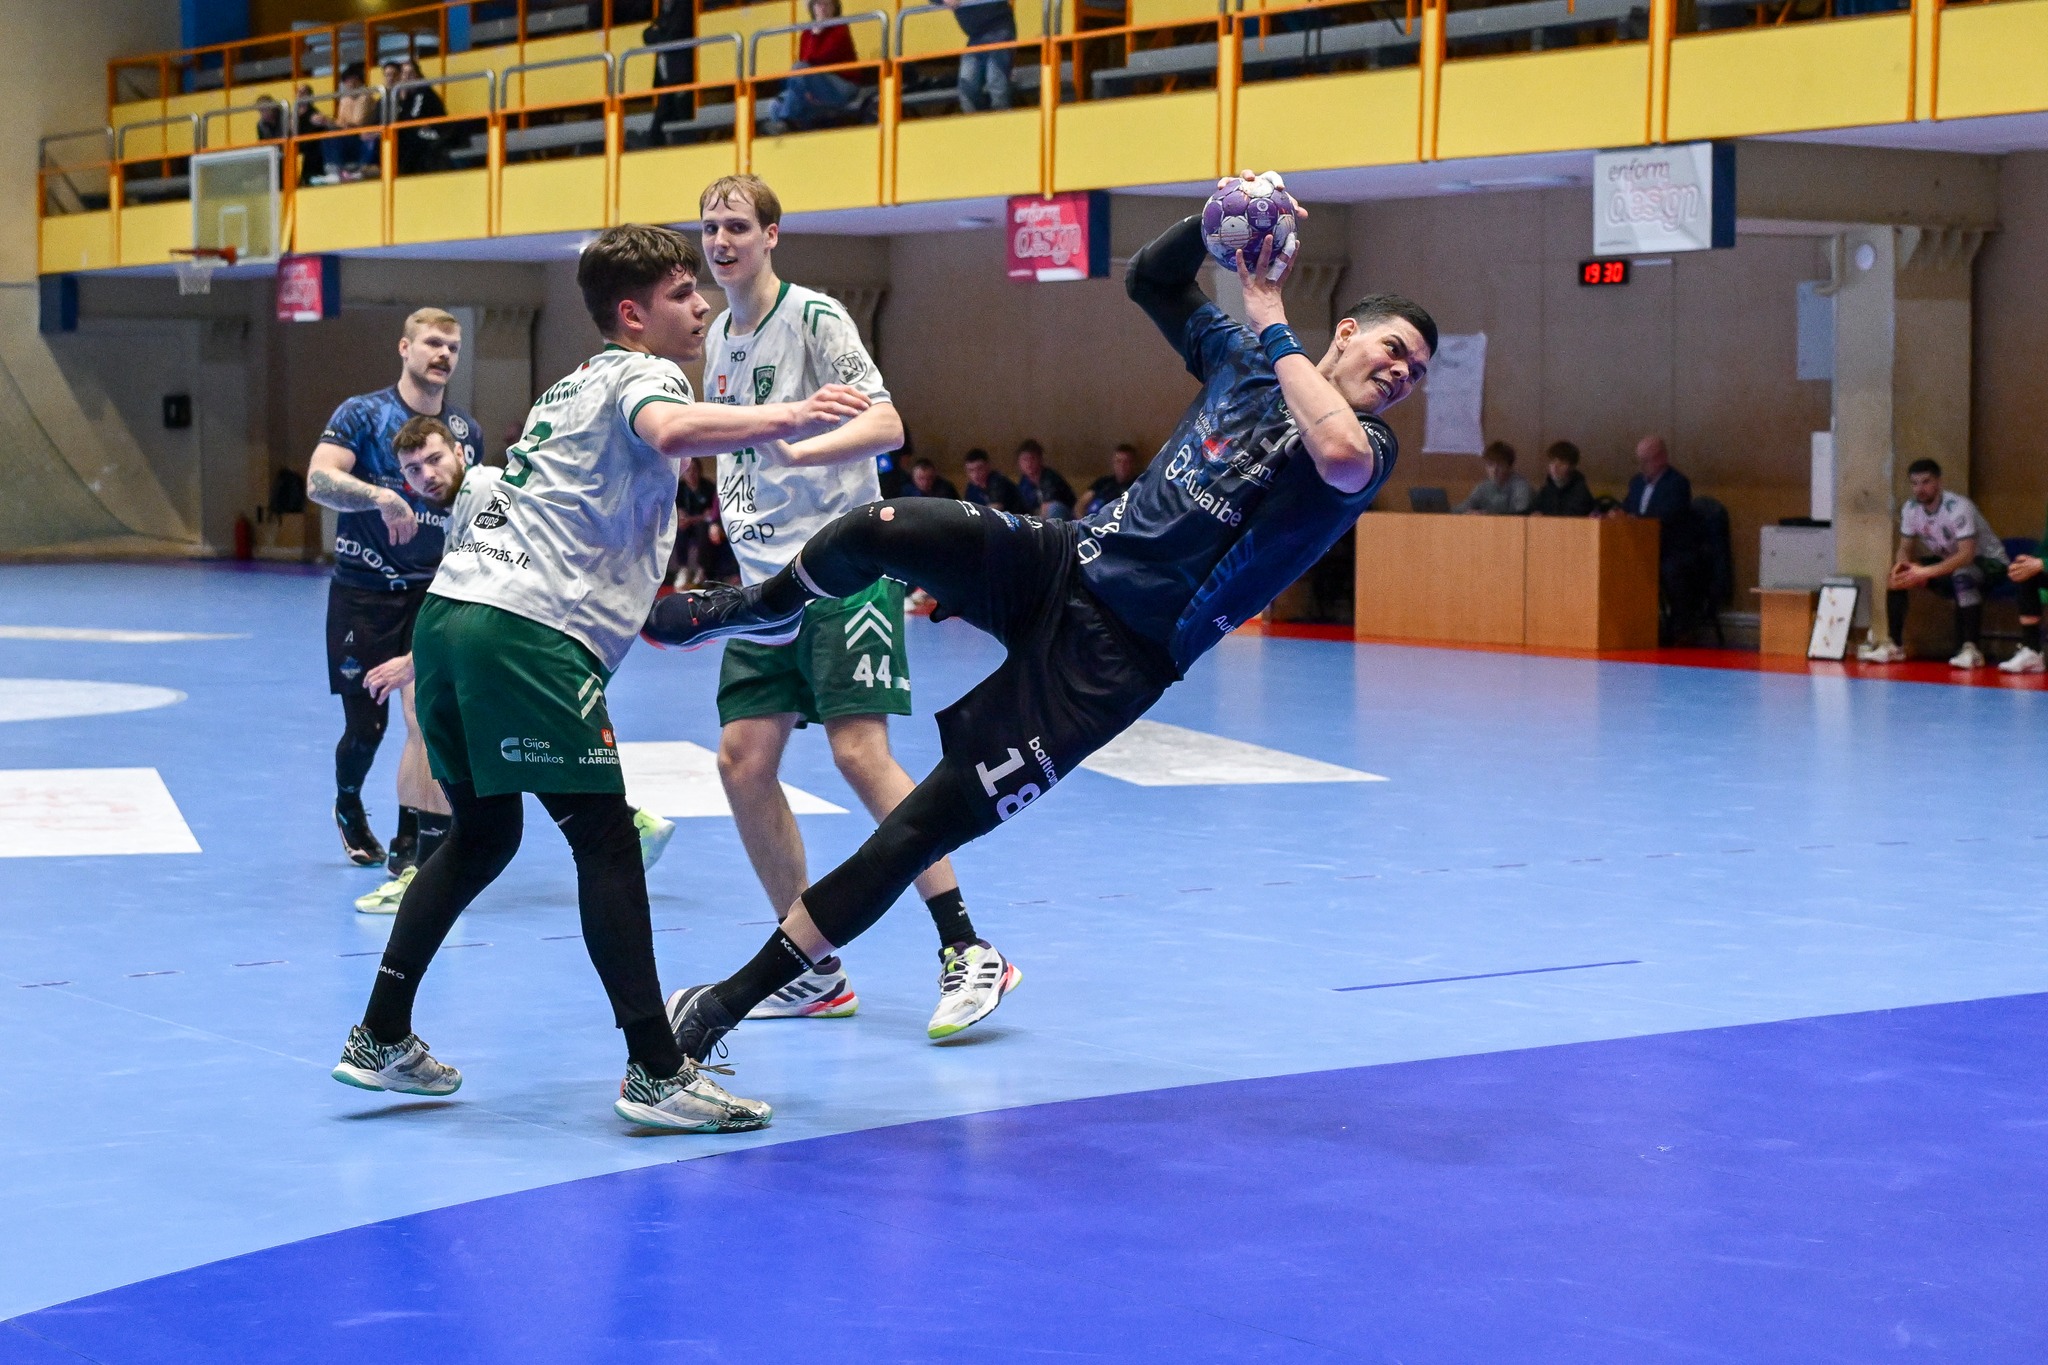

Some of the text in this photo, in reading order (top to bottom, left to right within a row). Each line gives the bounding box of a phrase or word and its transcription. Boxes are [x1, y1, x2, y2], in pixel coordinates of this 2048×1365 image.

[1608, 184, 1700, 232] design
[852, 653, 893, 689] 44
[523, 738, 551, 750] Gijos
[524, 752, 564, 764] Klinikos
[975, 747, 1041, 822] 18
